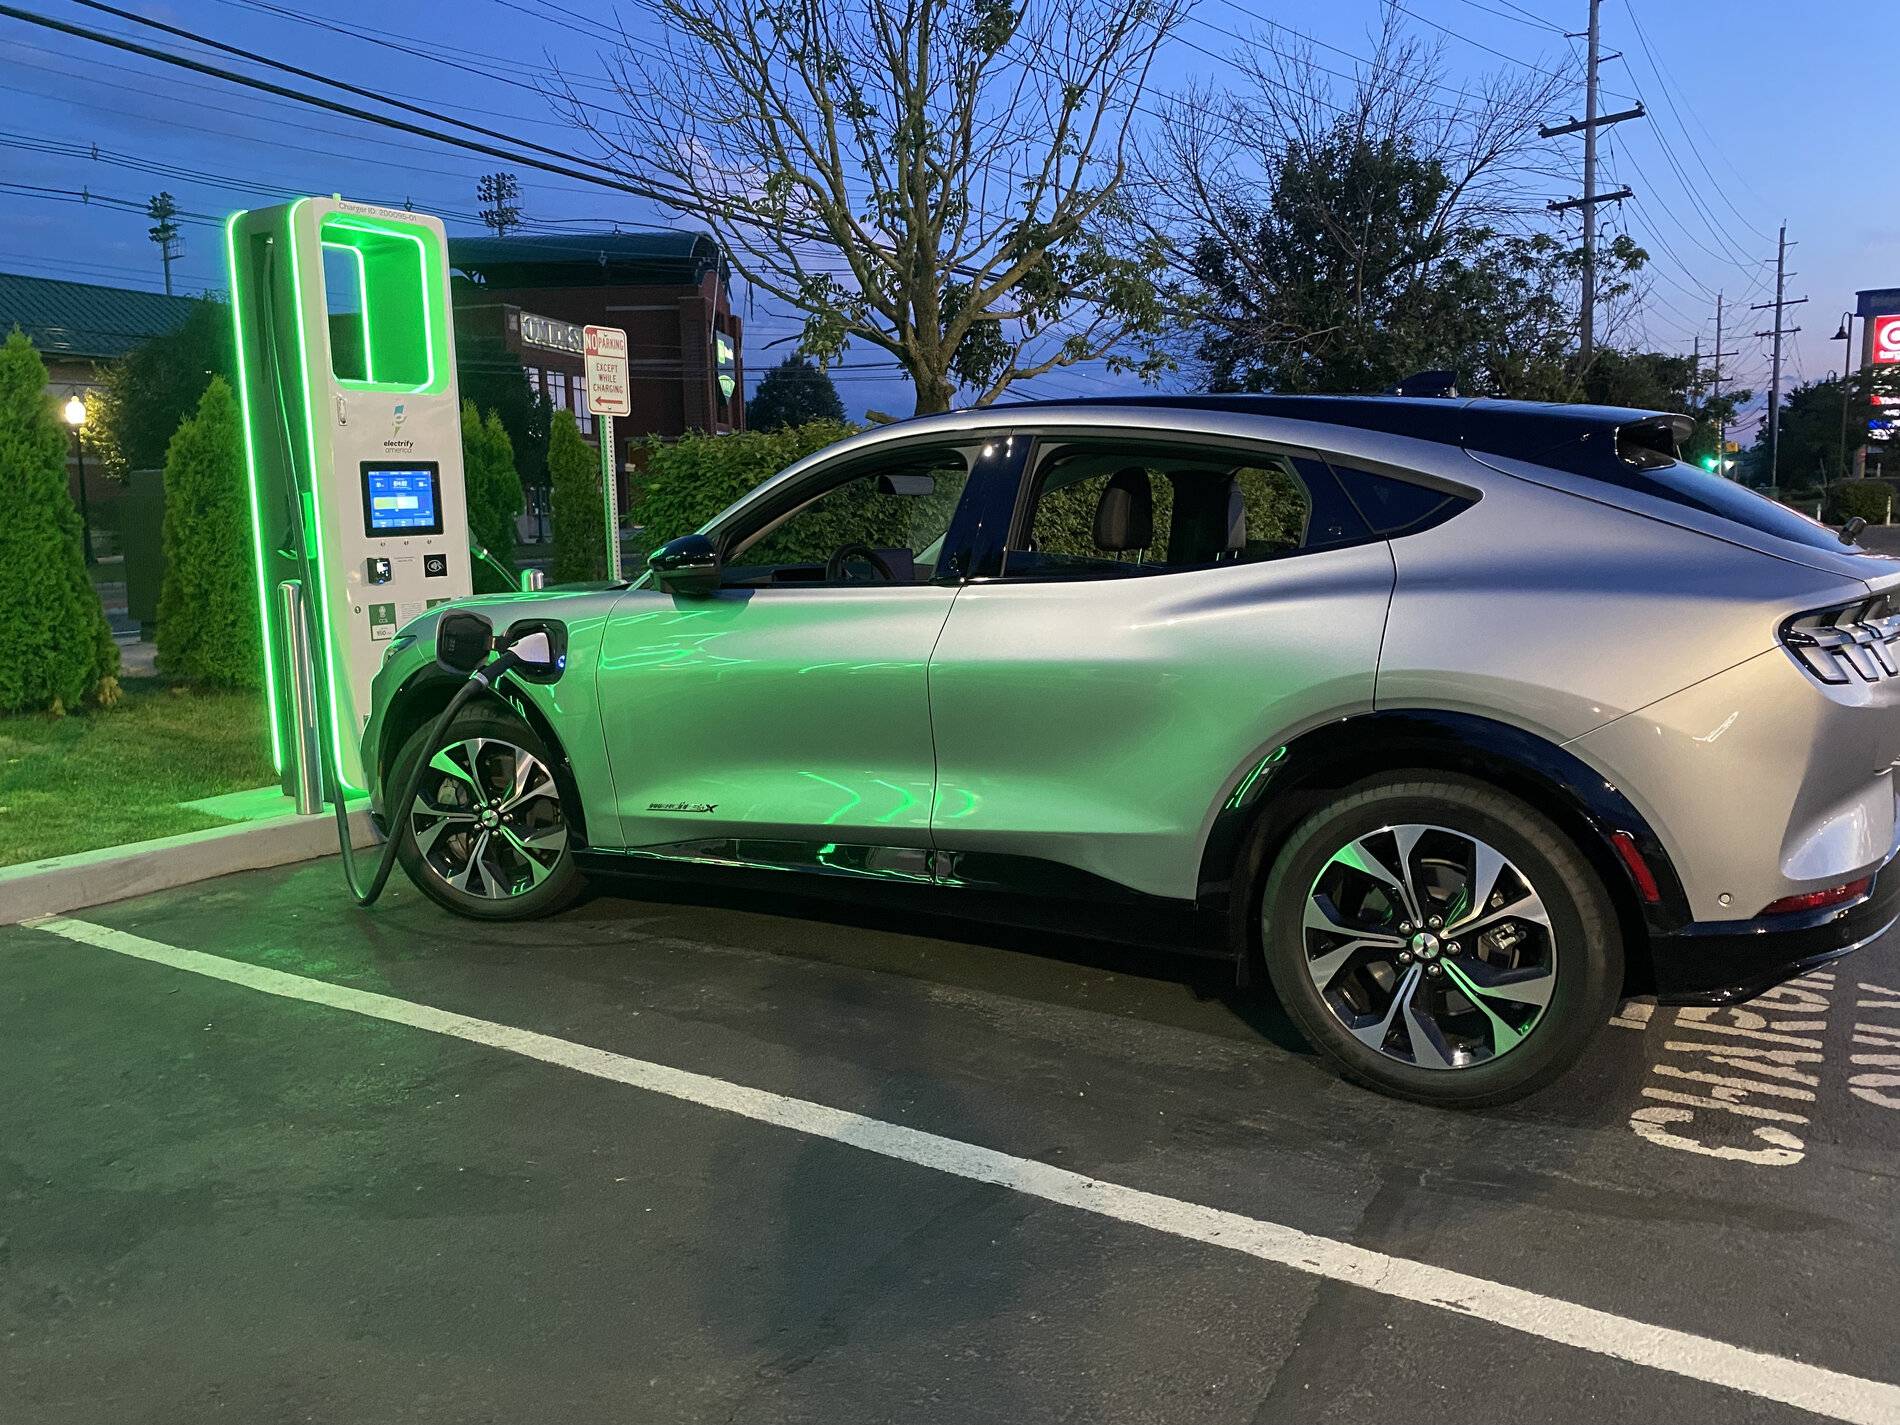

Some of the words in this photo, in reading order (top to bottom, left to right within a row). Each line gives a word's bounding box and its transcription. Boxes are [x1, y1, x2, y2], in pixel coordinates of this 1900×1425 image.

[339, 203, 366, 214] Charger
[586, 333, 598, 350] NO
[599, 338, 624, 351] PARKING
[596, 363, 618, 373] EXCEPT
[599, 374, 617, 383] WHILE
[593, 384, 624, 394] CHARGING
[383, 440, 414, 449] electrify
